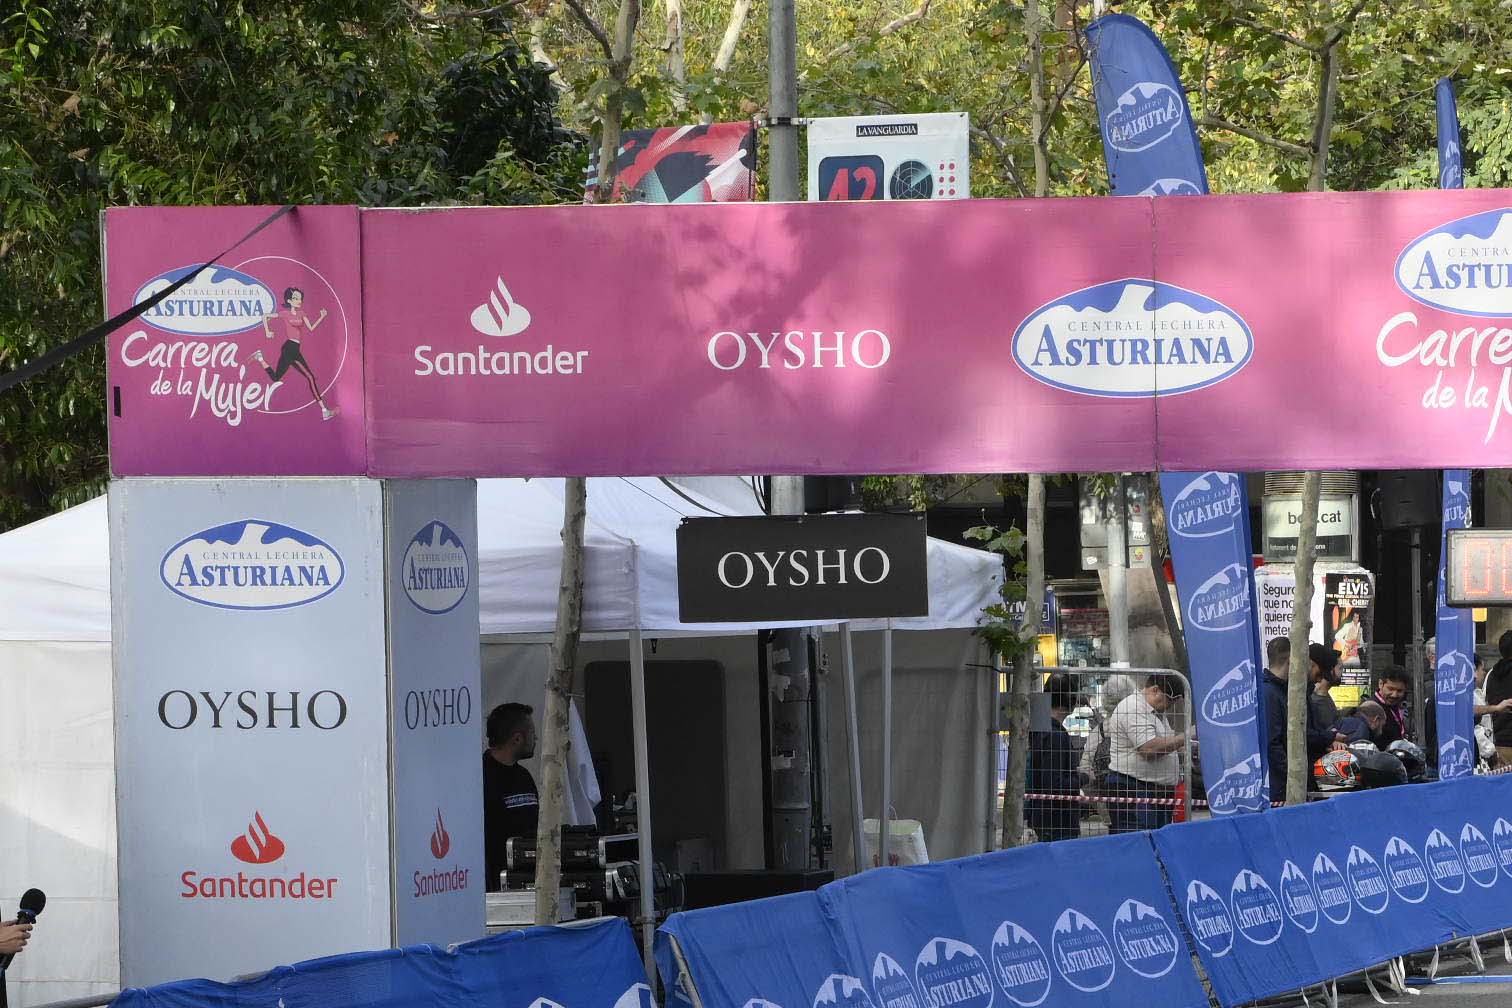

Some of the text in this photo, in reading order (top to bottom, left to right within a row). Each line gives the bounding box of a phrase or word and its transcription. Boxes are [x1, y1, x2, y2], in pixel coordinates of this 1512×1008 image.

[1068, 319, 1227, 332] CENTRAL LECHERA
[121, 331, 239, 371] Carrera
[415, 344, 589, 376] Santander
[708, 329, 891, 371] OYSHO
[1031, 324, 1234, 368] ASTURIANA
[150, 363, 287, 427] de la Mujer
[1422, 370, 1455, 409] de
[1464, 372, 1489, 411] la
[174, 554, 331, 588] ASTURIANA
[203, 551, 325, 560] CENTRAL LECHERA
[717, 547, 891, 589] OYSHO
[407, 560, 466, 591] ASTURIANA
[1339, 582, 1369, 595] ELVIS
[157, 690, 348, 730] OYSHO
[404, 686, 471, 730] OYSHO
[181, 870, 338, 899] Santander
[413, 864, 469, 898] Santander
[998, 957, 1048, 989] ASTURIANA
[1058, 942, 1113, 975] ASTURIANA
